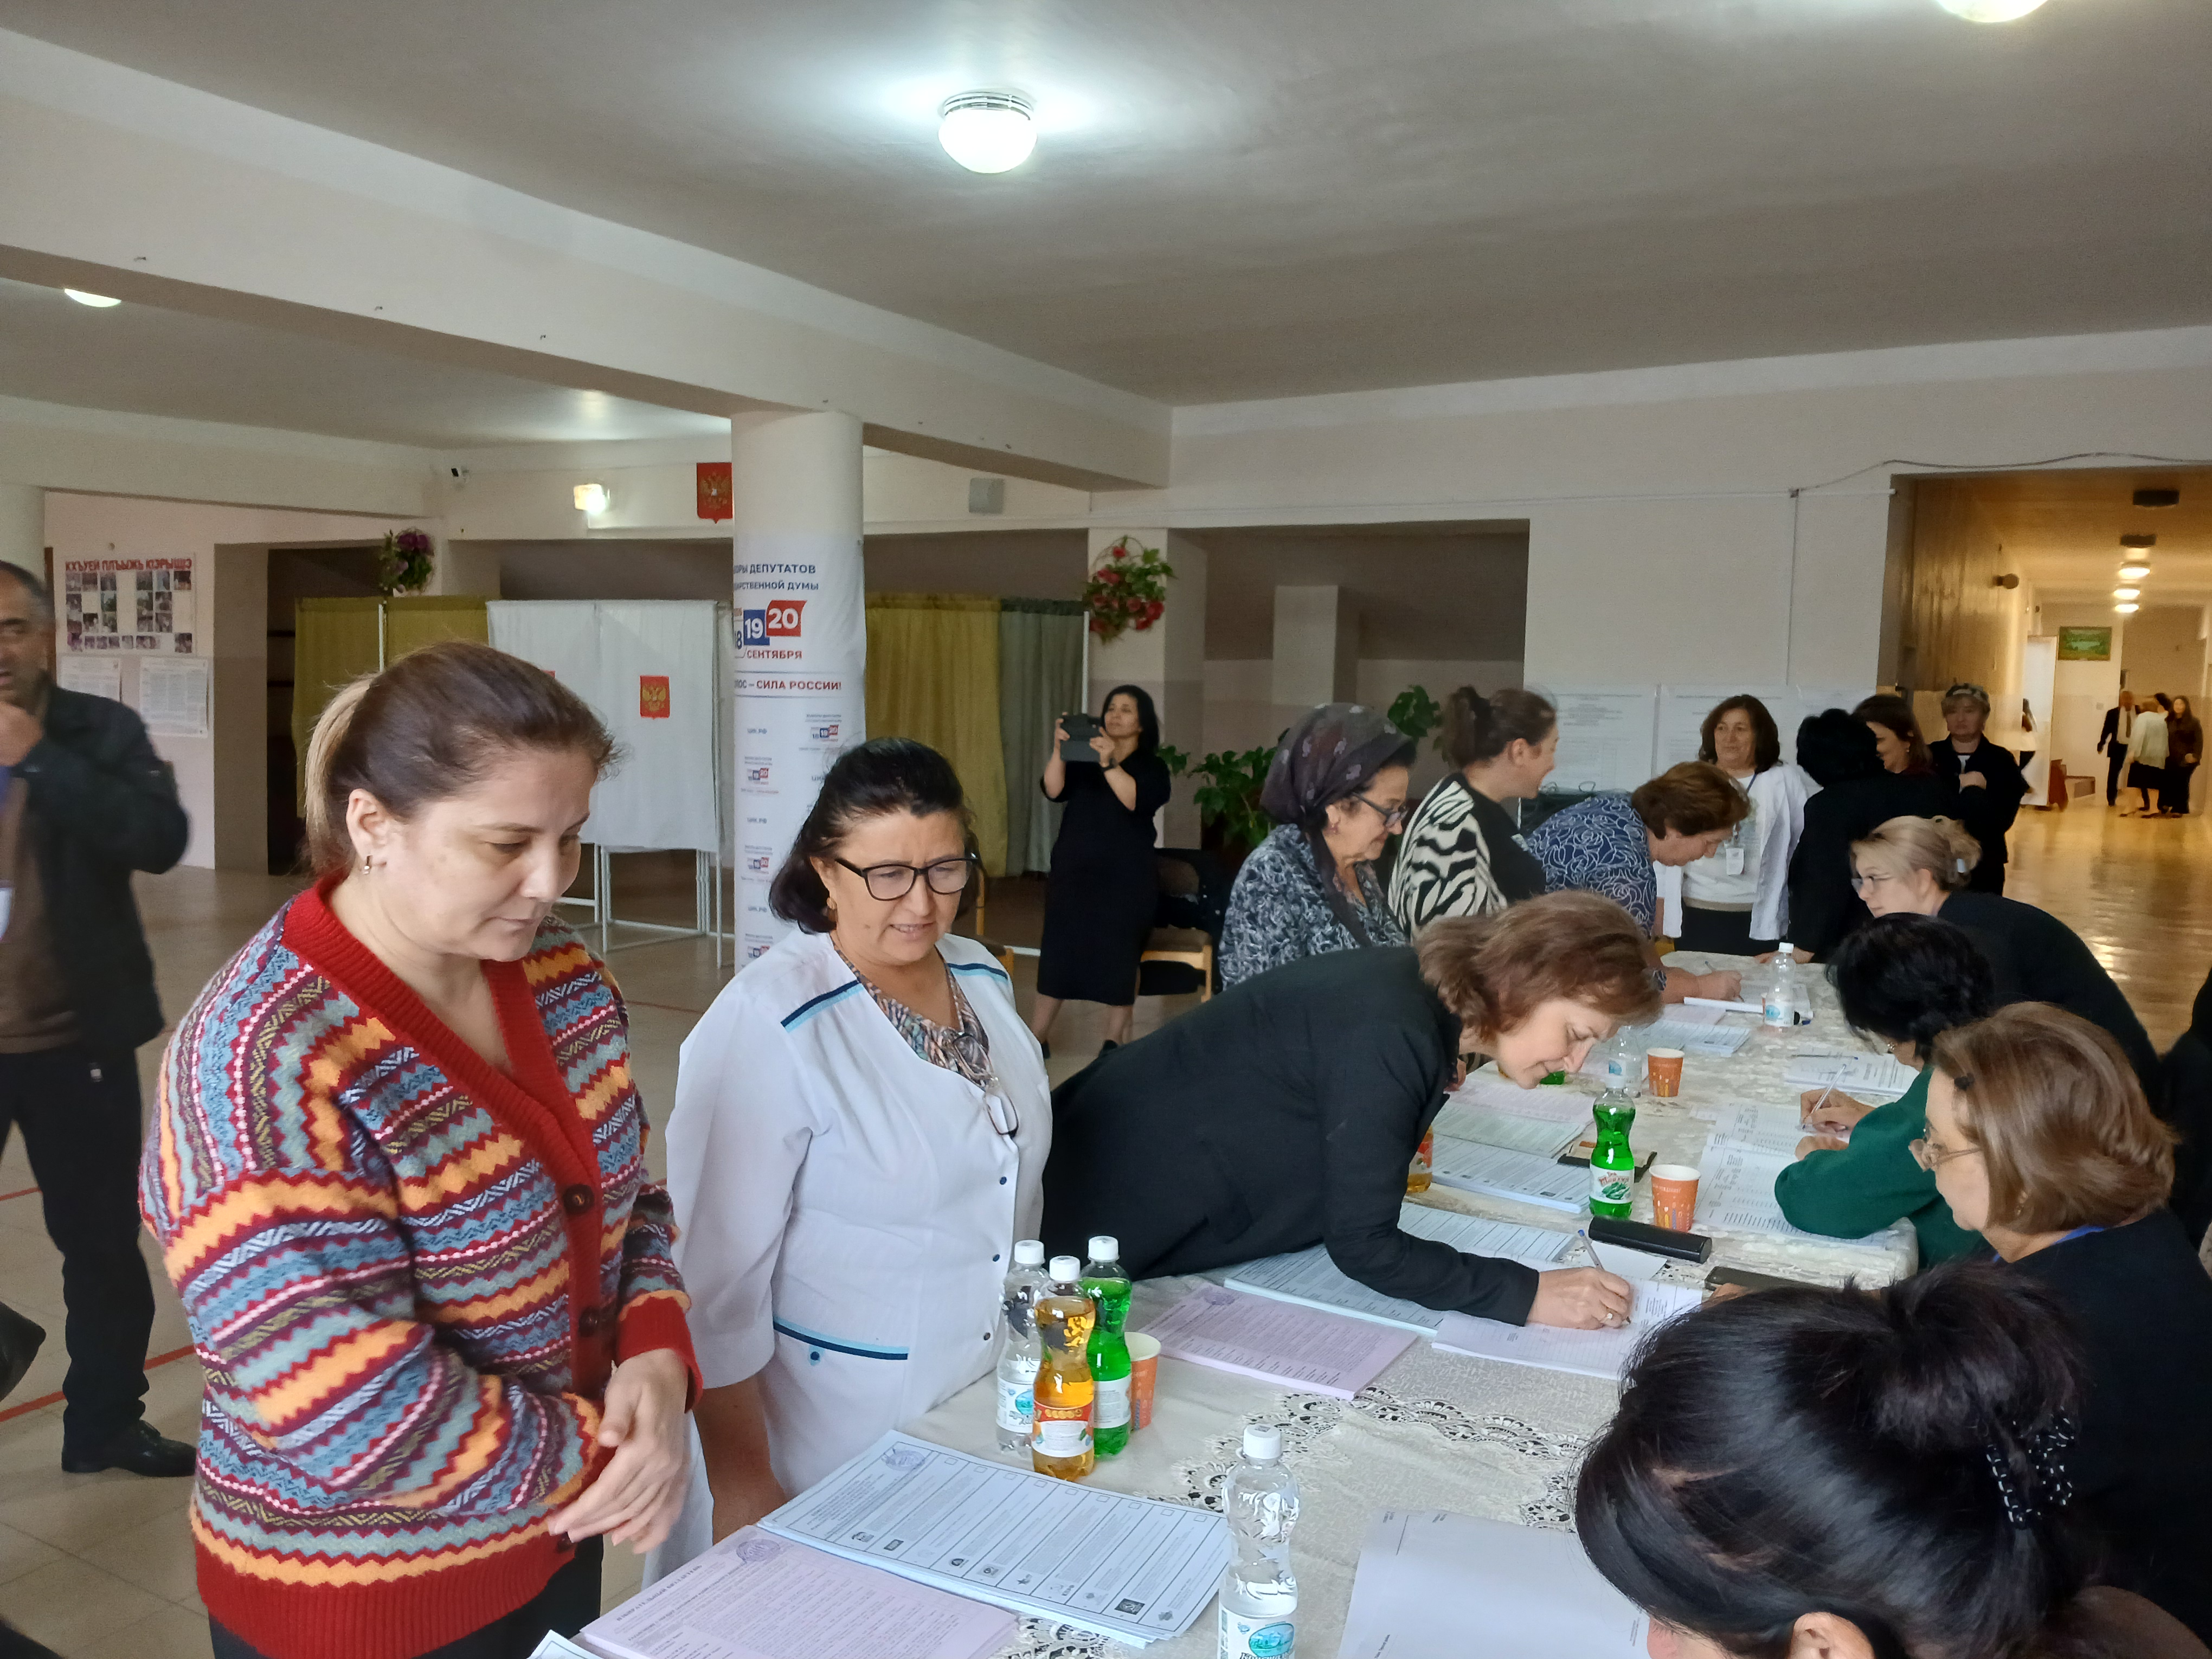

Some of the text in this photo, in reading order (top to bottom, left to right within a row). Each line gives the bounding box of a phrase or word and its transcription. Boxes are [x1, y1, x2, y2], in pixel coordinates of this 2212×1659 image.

[750, 563, 815, 574] ДЕПУТАТОВ
[788, 582, 819, 590] ДУМЫ
[745, 618, 763, 639] 19
[768, 608, 799, 629] 20
[747, 650, 802, 659] СЕНТЯБРЯ
[757, 680, 786, 690] СИЛА
[790, 681, 841, 690] РОССИИ!
